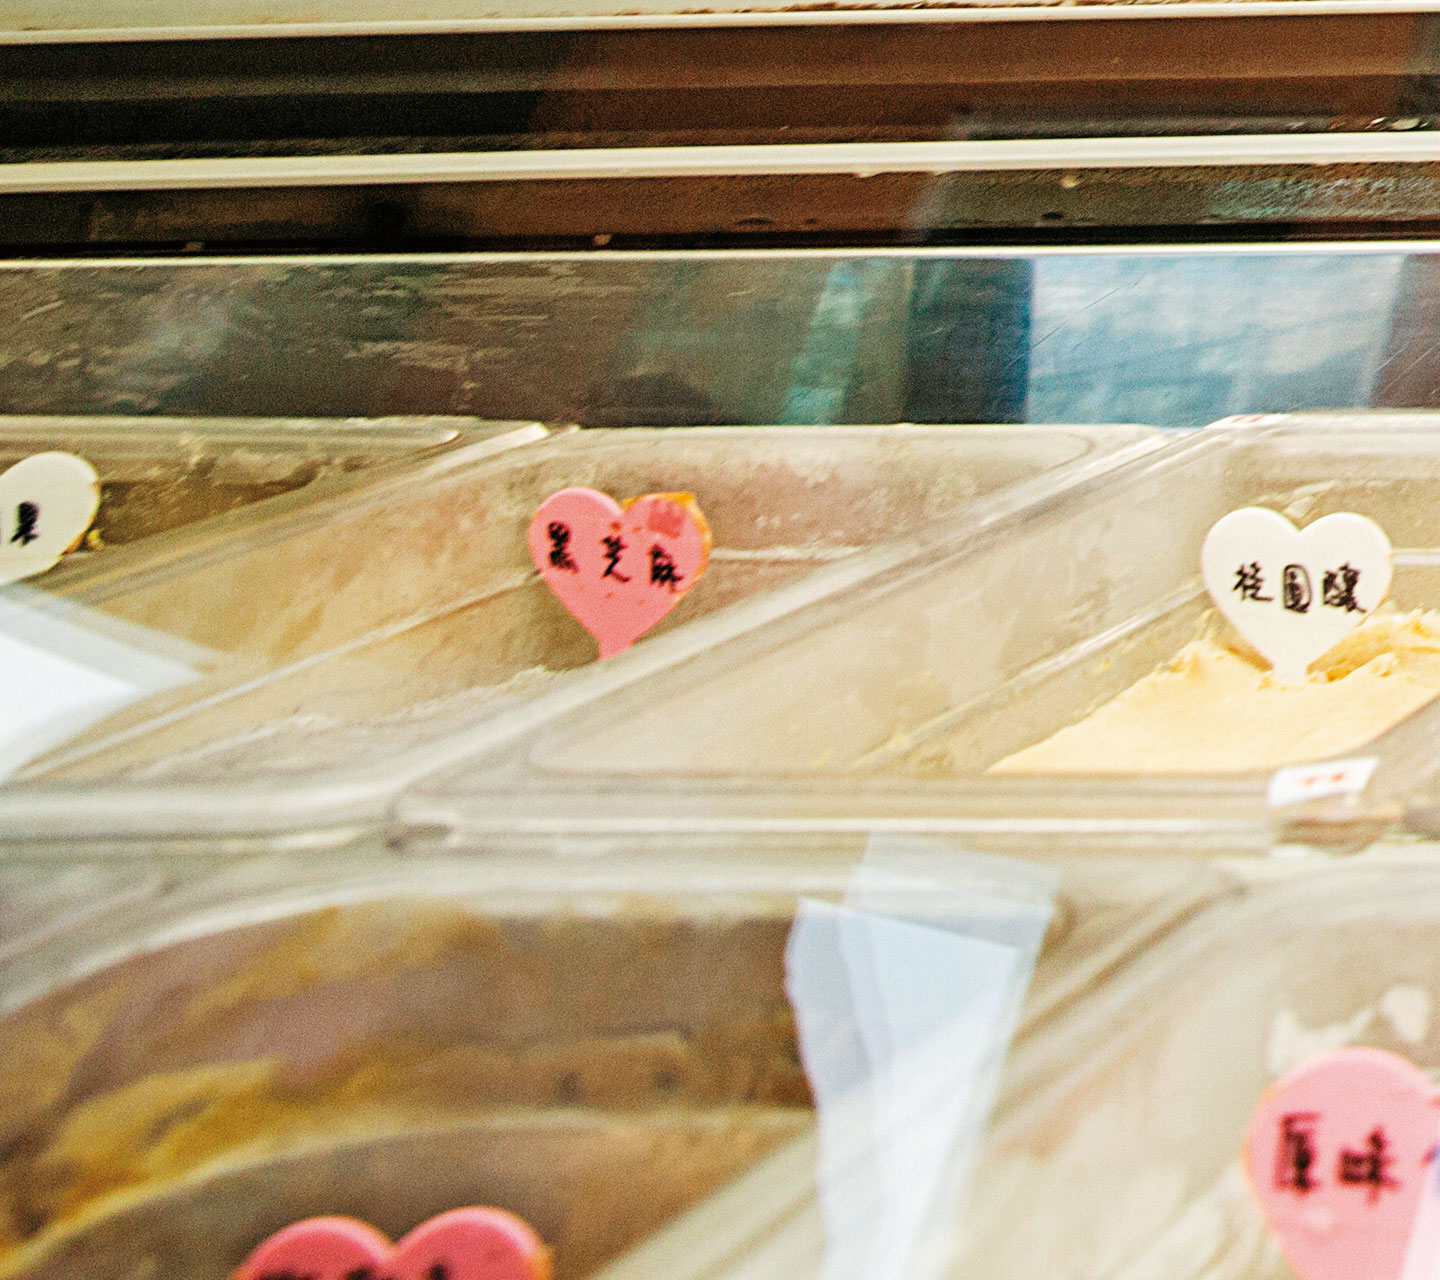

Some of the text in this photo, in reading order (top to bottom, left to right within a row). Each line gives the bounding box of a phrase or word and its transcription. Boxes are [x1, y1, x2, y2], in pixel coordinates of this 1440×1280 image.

[0, 500, 42, 549] 果
[547, 520, 685, 595] 黑芝麻
